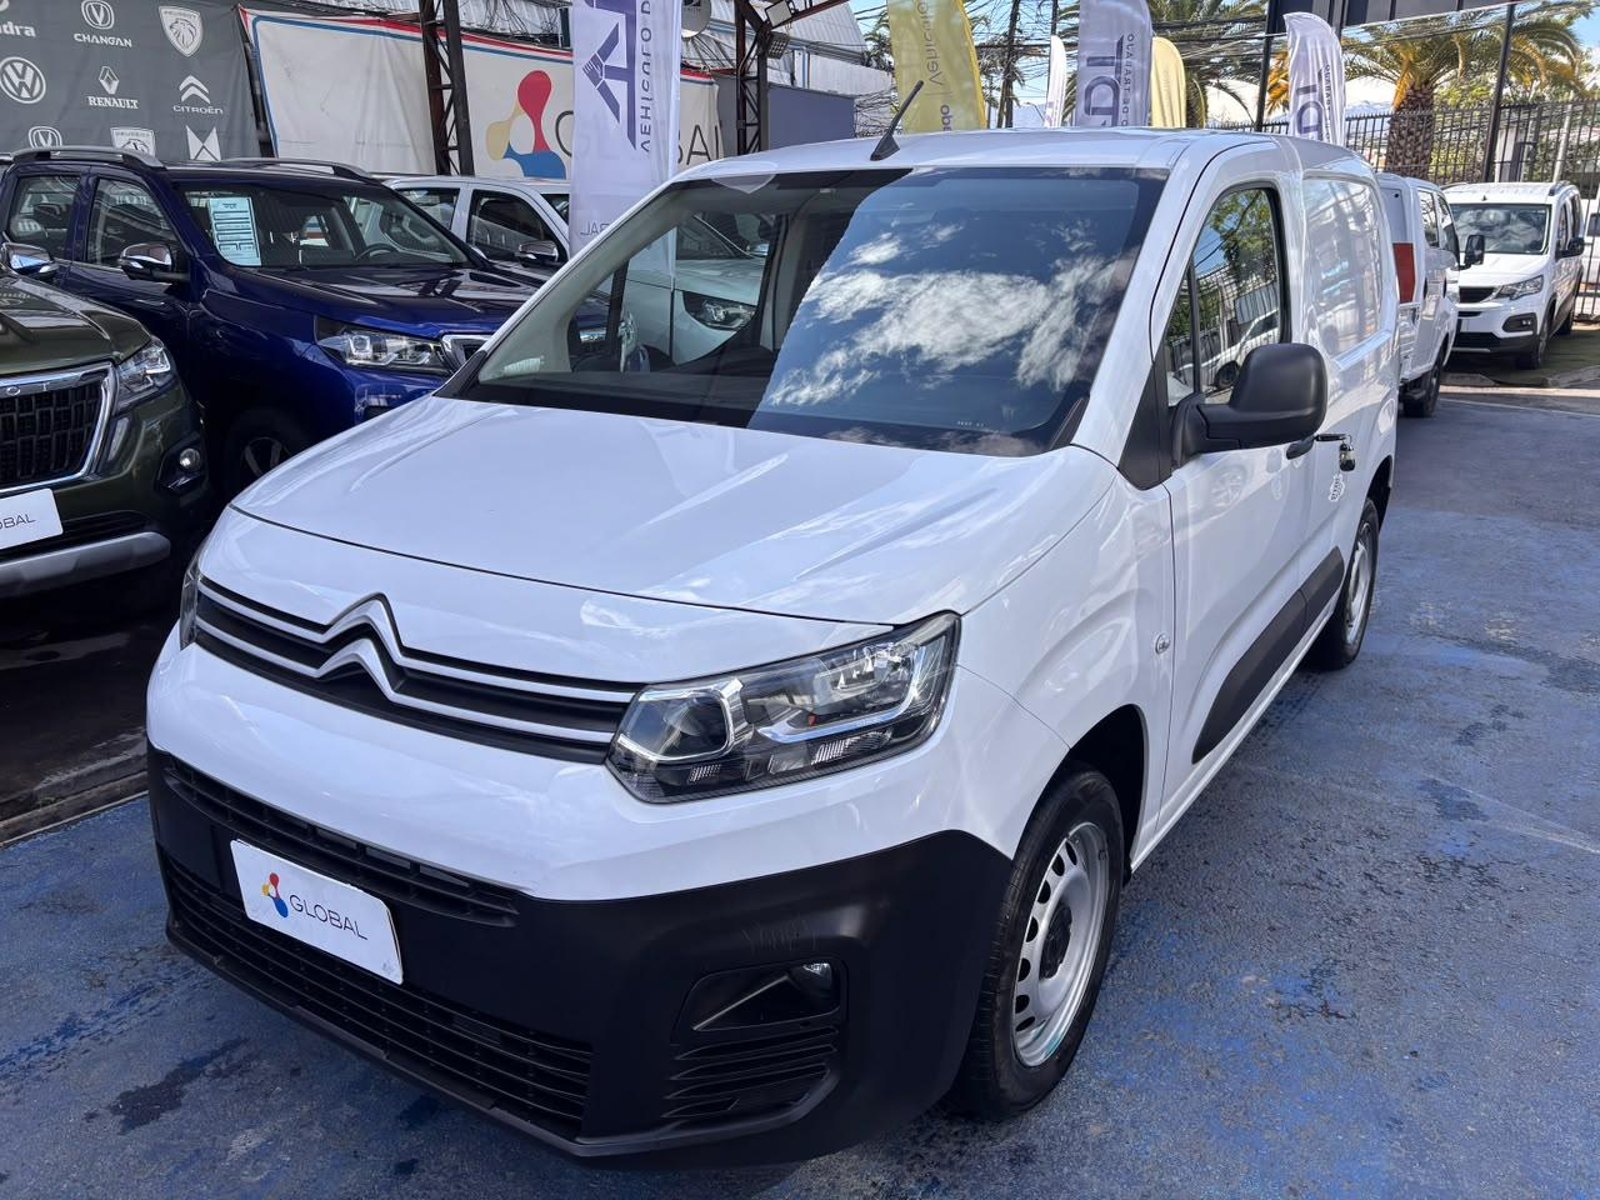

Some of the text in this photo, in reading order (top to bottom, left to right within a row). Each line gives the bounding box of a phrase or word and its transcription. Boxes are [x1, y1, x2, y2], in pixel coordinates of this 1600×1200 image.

[73, 33, 132, 48] CHANGAN
[87, 95, 139, 109] RENAULT
[289, 894, 368, 941] GLOBAL
